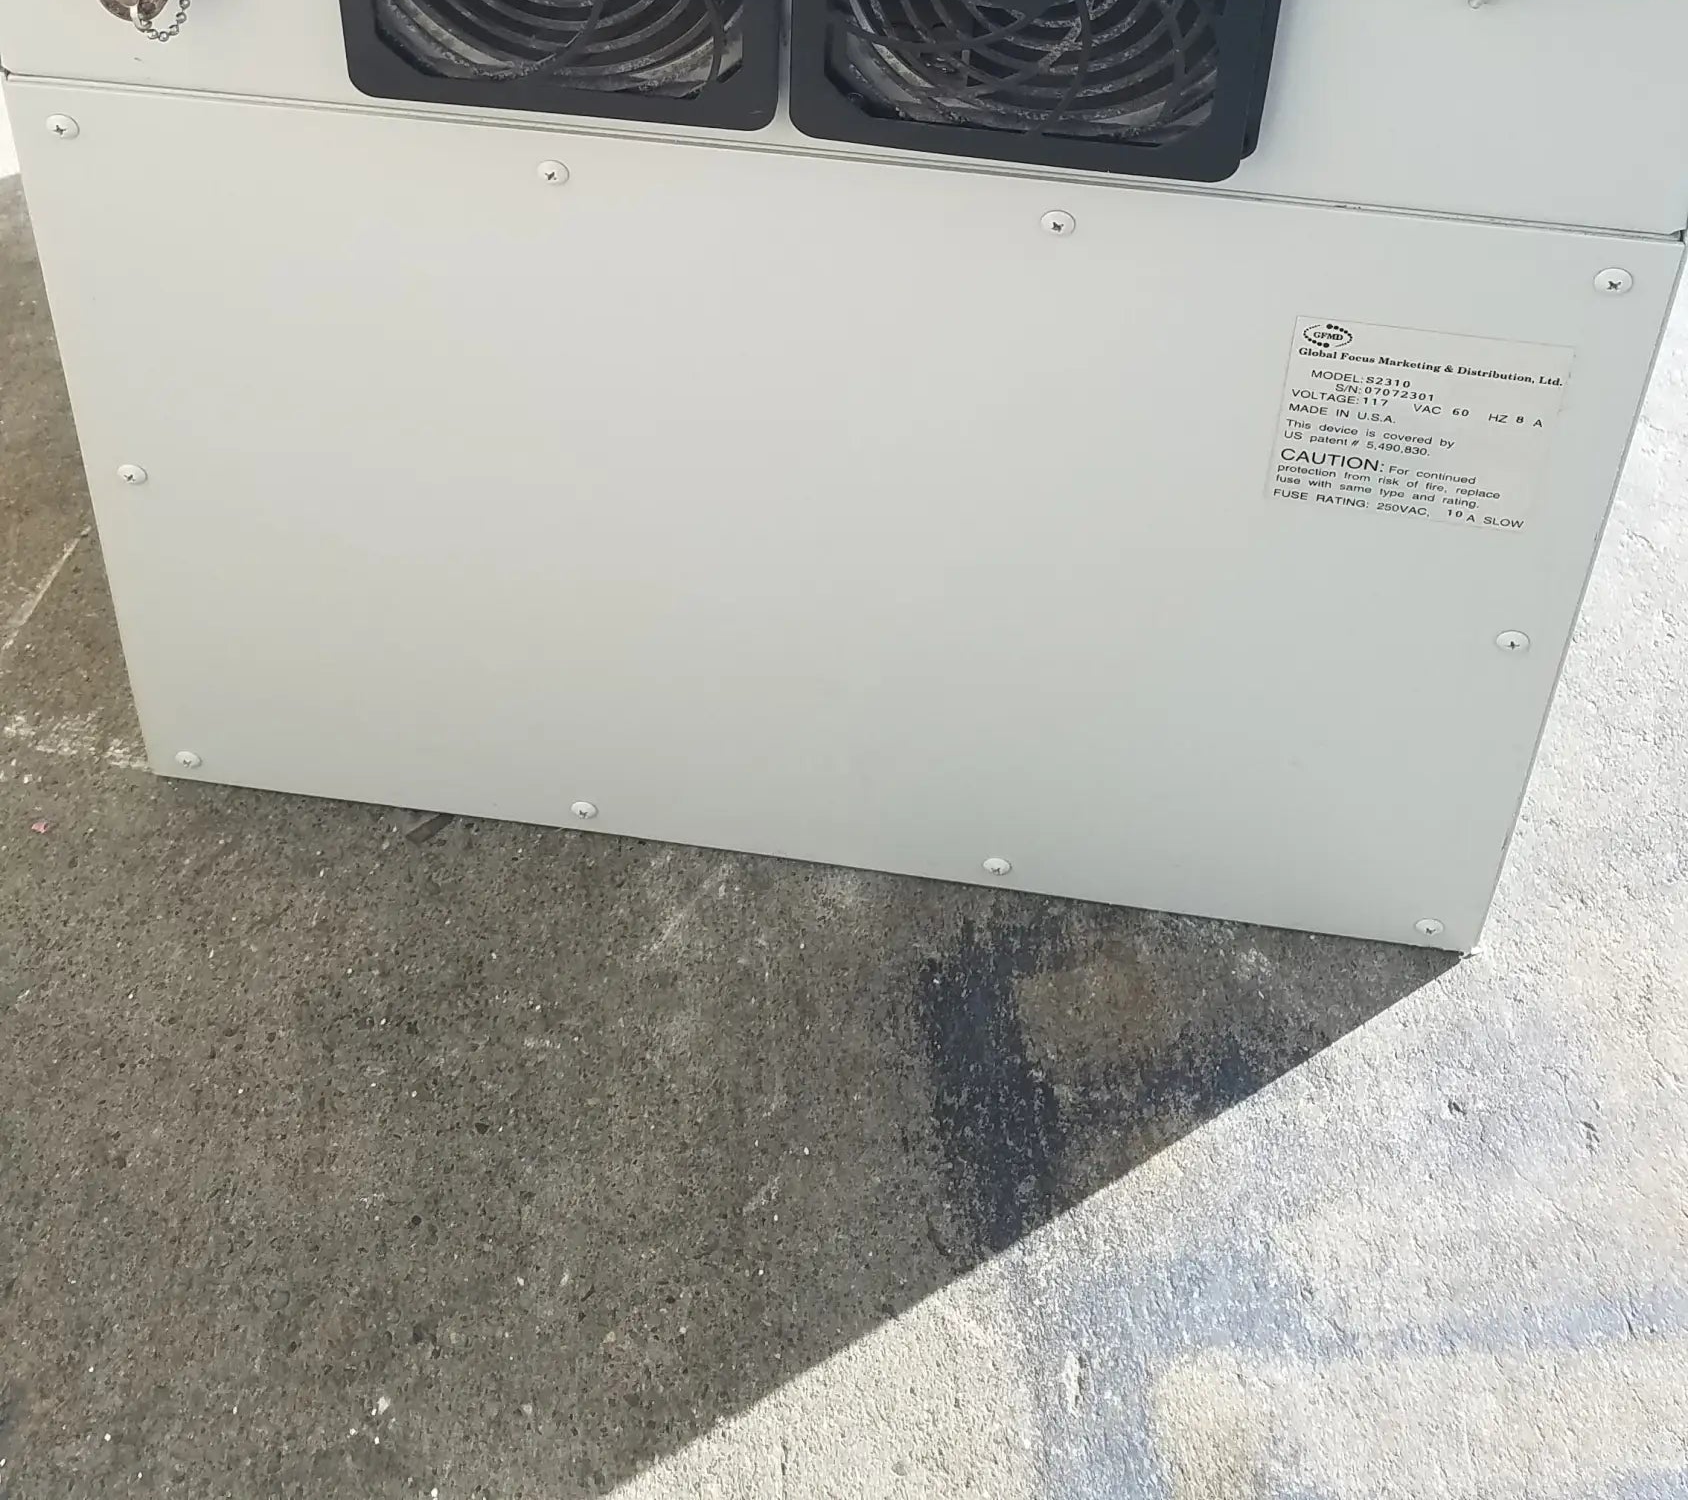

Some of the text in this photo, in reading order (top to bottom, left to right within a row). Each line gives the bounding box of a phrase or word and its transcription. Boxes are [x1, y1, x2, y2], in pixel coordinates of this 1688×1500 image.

[1313, 331, 1344, 341] GFMD
[1298, 347, 1563, 386] Global Focus Marketing & Distribution, Ltd.
[1288, 402, 1396, 424] MADE IN U.S.A.
[1413, 404, 1442, 414] VAC
[1452, 408, 1470, 417] 60
[1488, 413, 1508, 424] HZ
[1516, 416, 1524, 424] 8
[1532, 419, 1543, 428] A
[1284, 430, 1302, 440] US
[1310, 434, 1348, 446] patent
[1286, 418, 1455, 450] This device is covered by
[1277, 464, 1336, 478] protection
[1344, 471, 1371, 482] from
[1378, 476, 1400, 486] risk
[1406, 480, 1418, 488] of
[1455, 488, 1500, 500] replace
[1280, 448, 1476, 484] CAUTION: For continued
[1273, 488, 1308, 500] FUSE
[1316, 494, 1370, 508] RATING:
[1483, 516, 1524, 528] SLOW
[1276, 474, 1480, 510] fuse with same type and rating.
